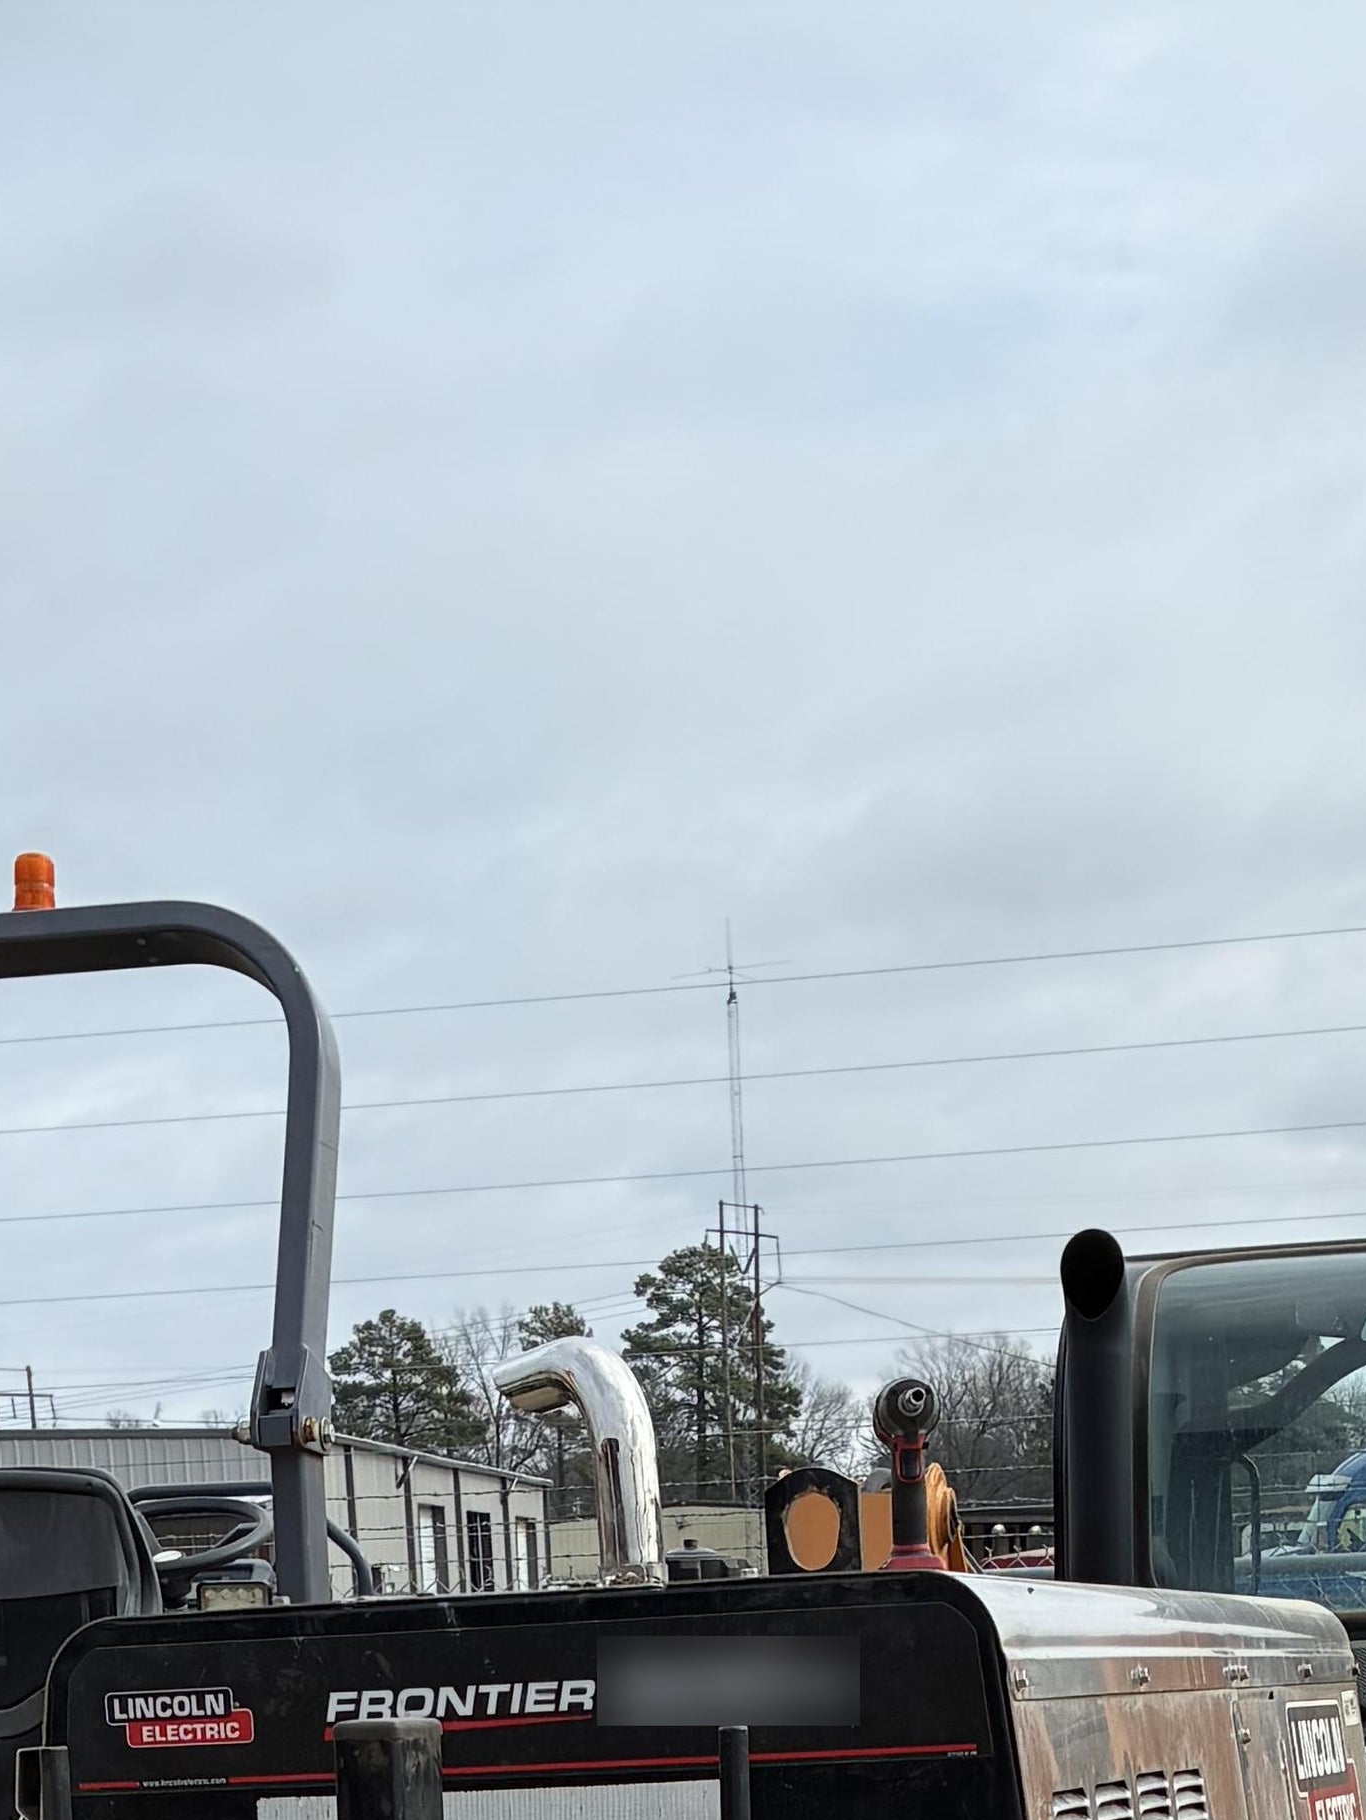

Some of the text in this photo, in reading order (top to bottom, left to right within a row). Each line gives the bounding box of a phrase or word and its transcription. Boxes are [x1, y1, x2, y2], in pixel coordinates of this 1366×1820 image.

[113, 1692, 225, 1720] LINCOLN
[326, 1679, 596, 1722] FRONTIER
[141, 1722, 240, 1743] ELECTRIC
[1290, 1716, 1346, 1780] LINCOLN
